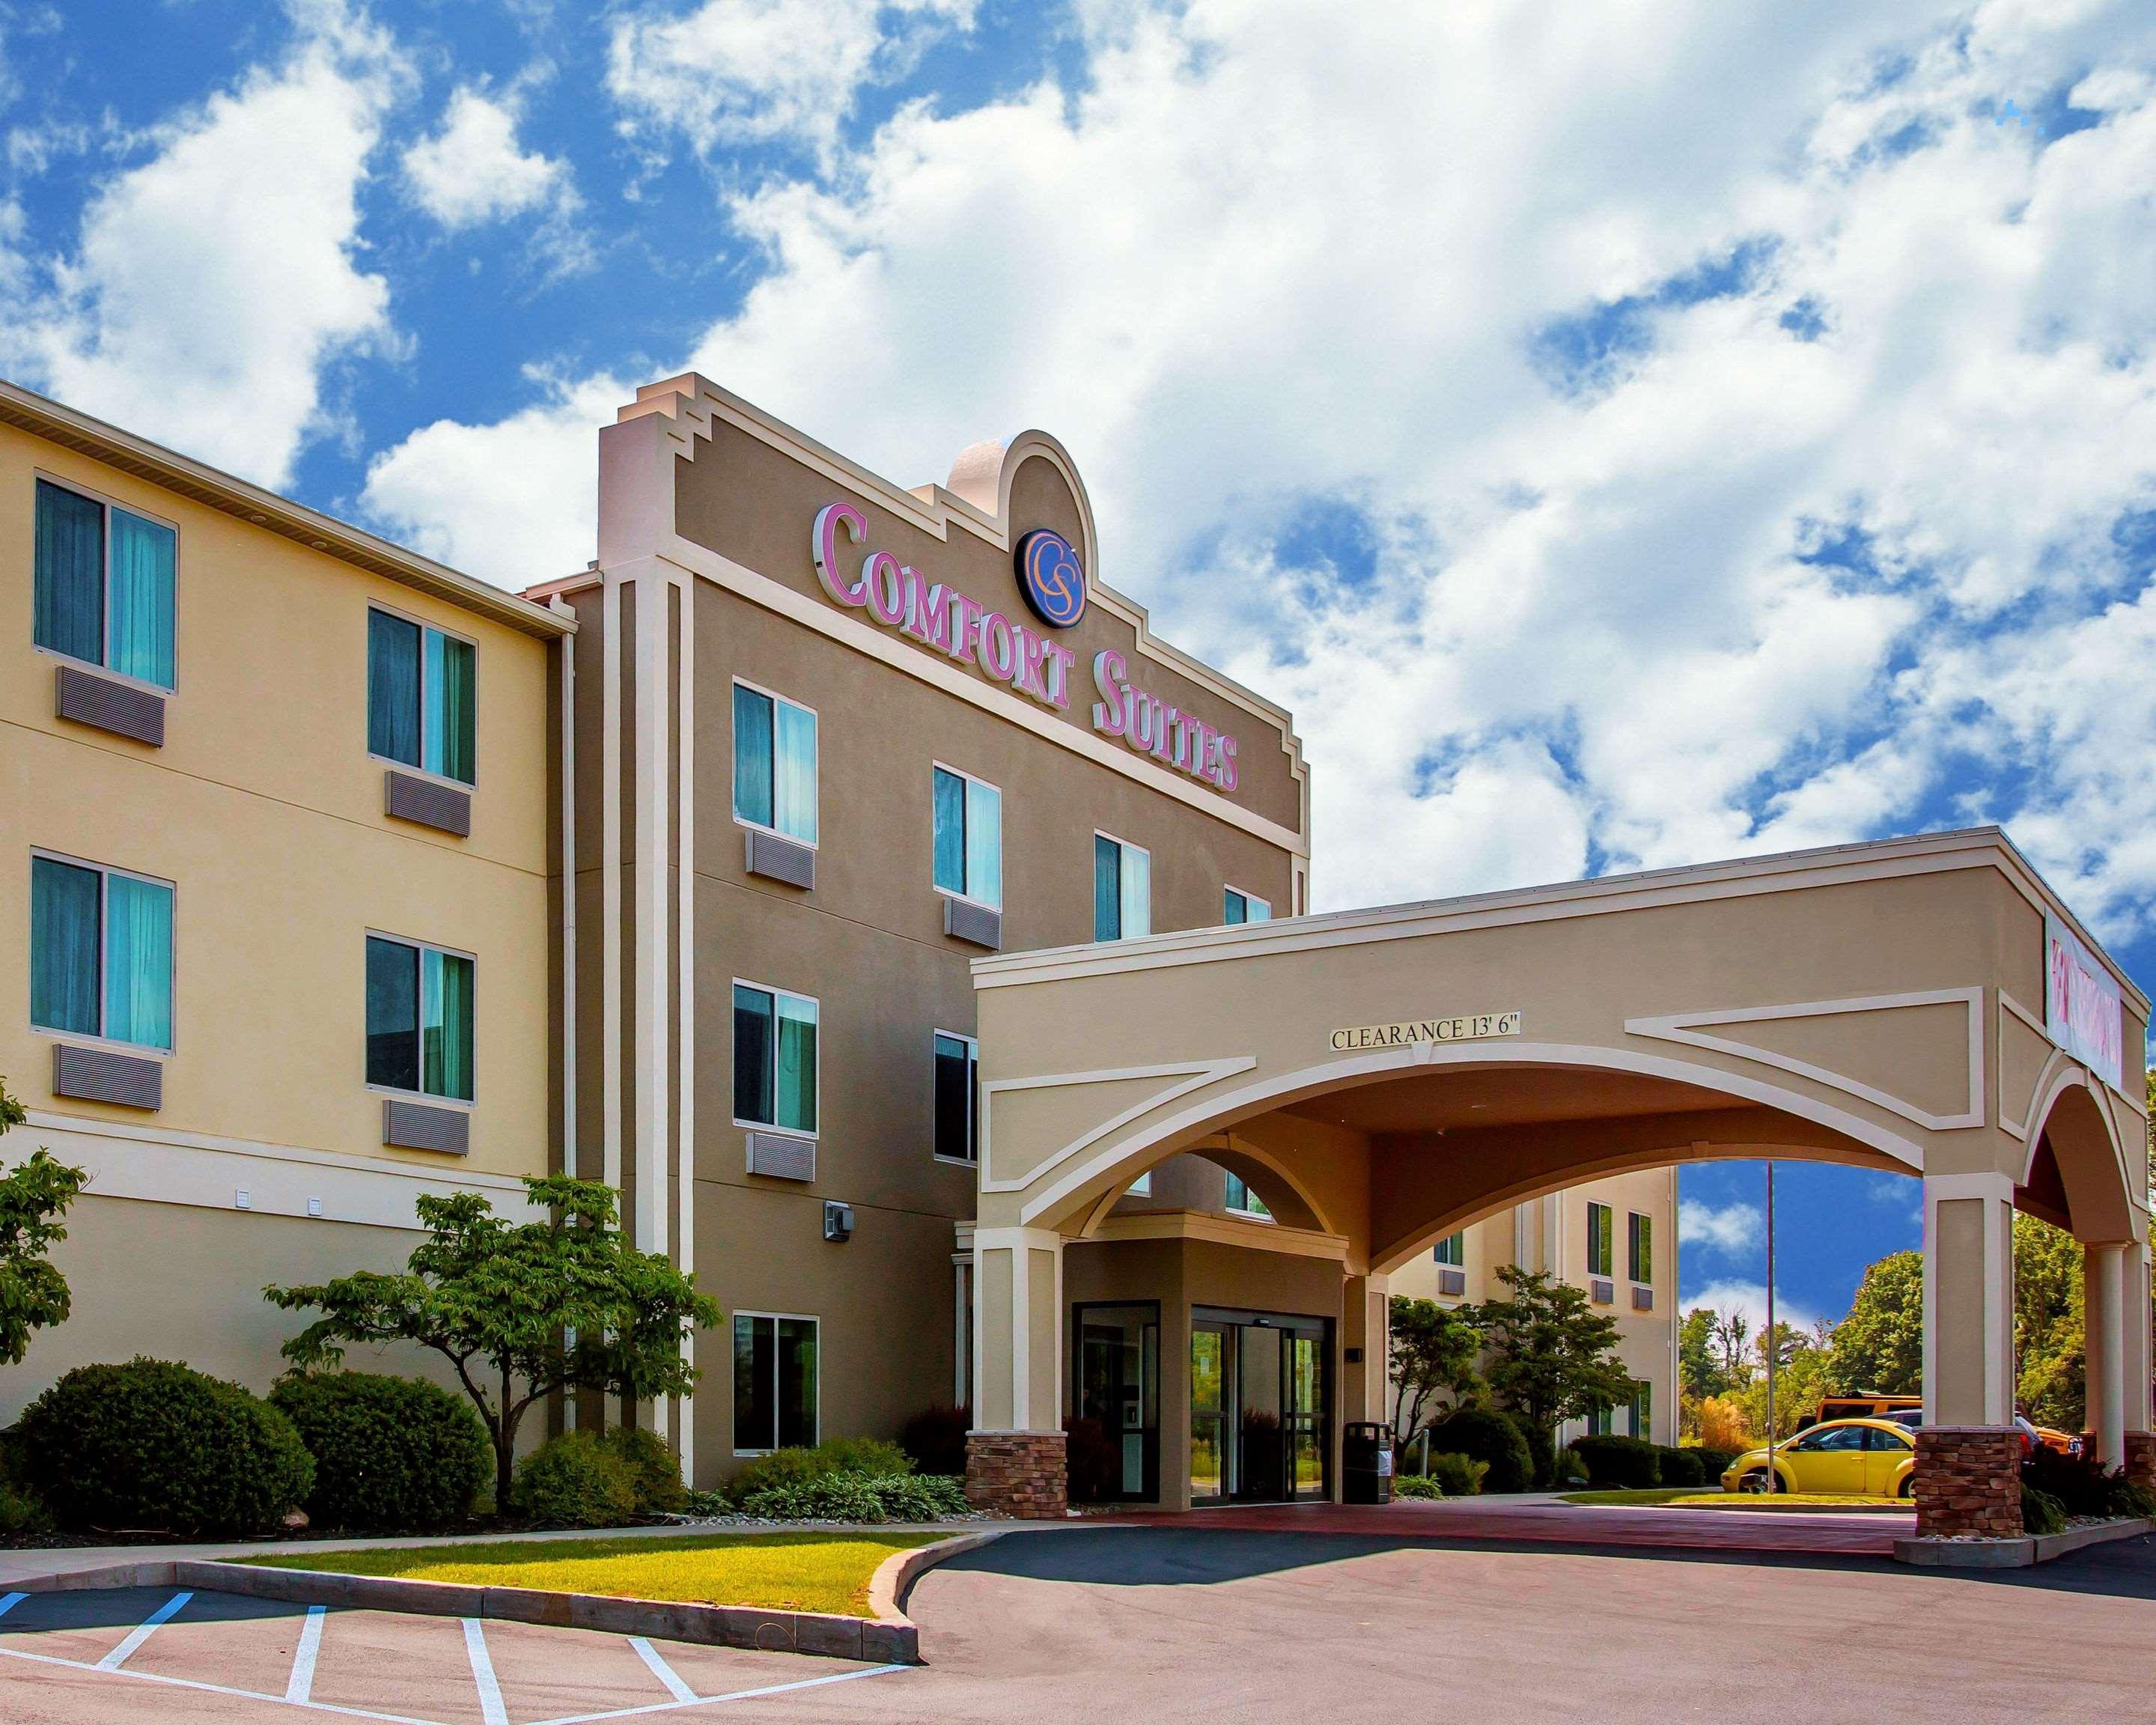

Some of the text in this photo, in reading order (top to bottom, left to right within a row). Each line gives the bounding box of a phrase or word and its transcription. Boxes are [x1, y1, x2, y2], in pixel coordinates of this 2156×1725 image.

[812, 502, 1238, 792] COMFORT SUITES
[1332, 1020, 1464, 1049] CLEARANCE
